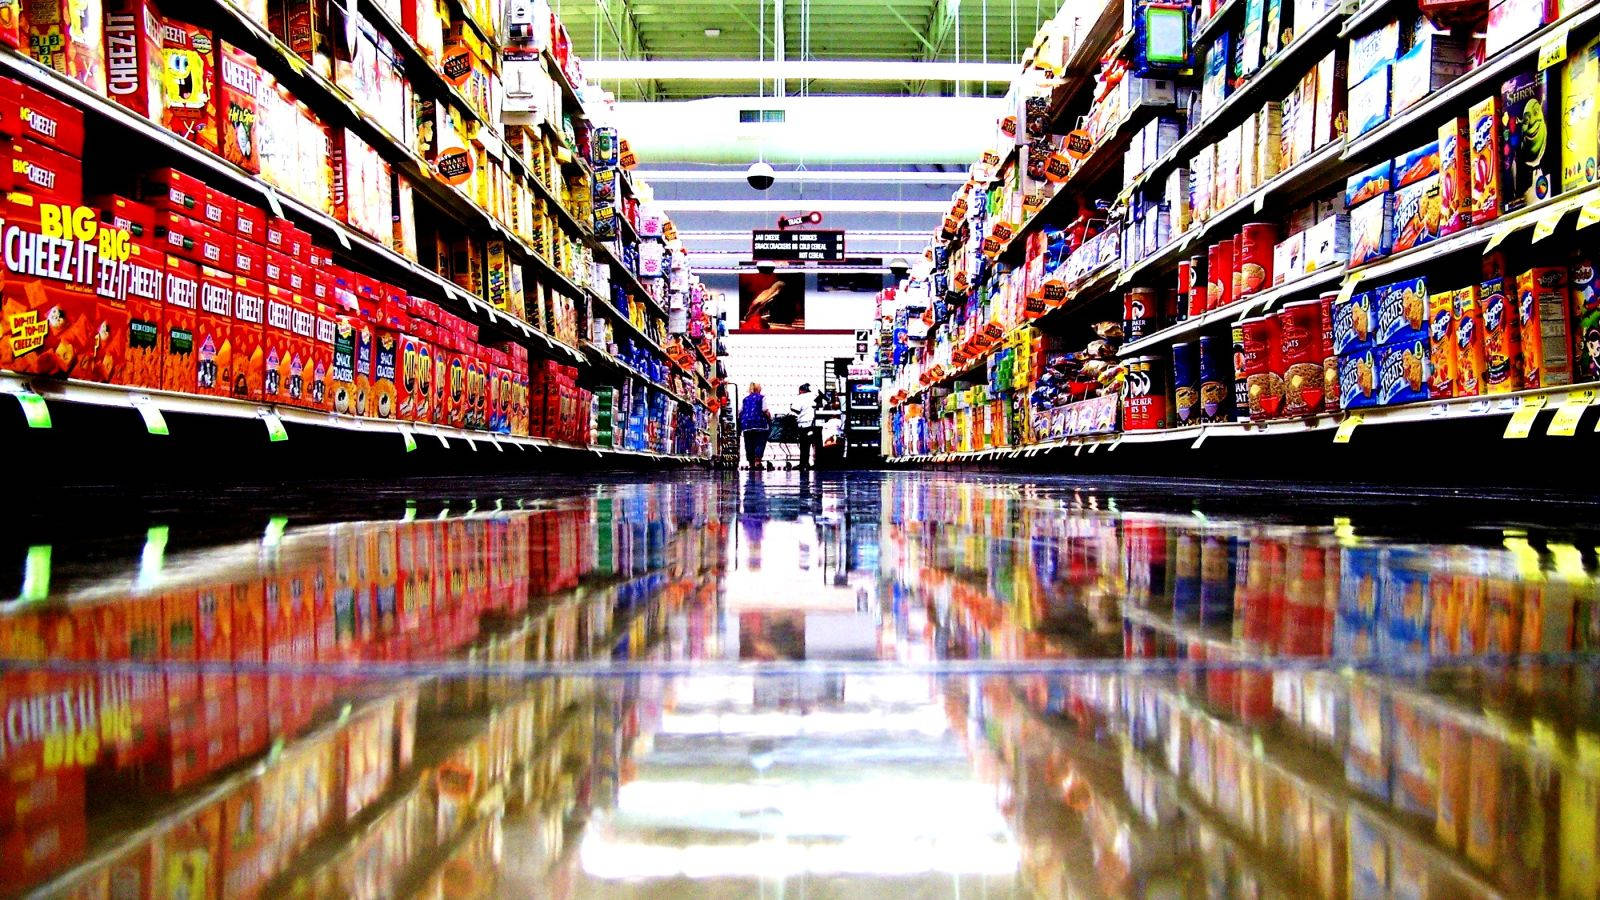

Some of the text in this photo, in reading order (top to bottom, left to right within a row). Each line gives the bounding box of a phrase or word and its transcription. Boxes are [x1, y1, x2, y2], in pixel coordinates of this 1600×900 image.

[104, 13, 138, 94] CHEEZ-IT
[222, 57, 259, 99] CHEEZ-IT
[20, 106, 31, 122] IG
[29, 111, 57, 138] CHEEZ-IT
[13, 159, 30, 175] BIG
[27, 164, 56, 189] CHEEZ-IT
[40, 203, 97, 241] BIG
[5, 225, 97, 285] CHEEZ-IT
[99, 227, 130, 262] BIG
[128, 262, 163, 301] HEEZ-IT
[166, 272, 198, 310] CHEEZ-IT
[201, 281, 233, 317] CHEEZ-IT
[235, 291, 264, 324] CHEEZ-IT
[267, 299, 292, 331] CHEEZ-IT
[291, 307, 315, 338] CHEEZ-IT
[1378, 299, 1404, 342] TREATS
[1381, 360, 1405, 402] TREATS
